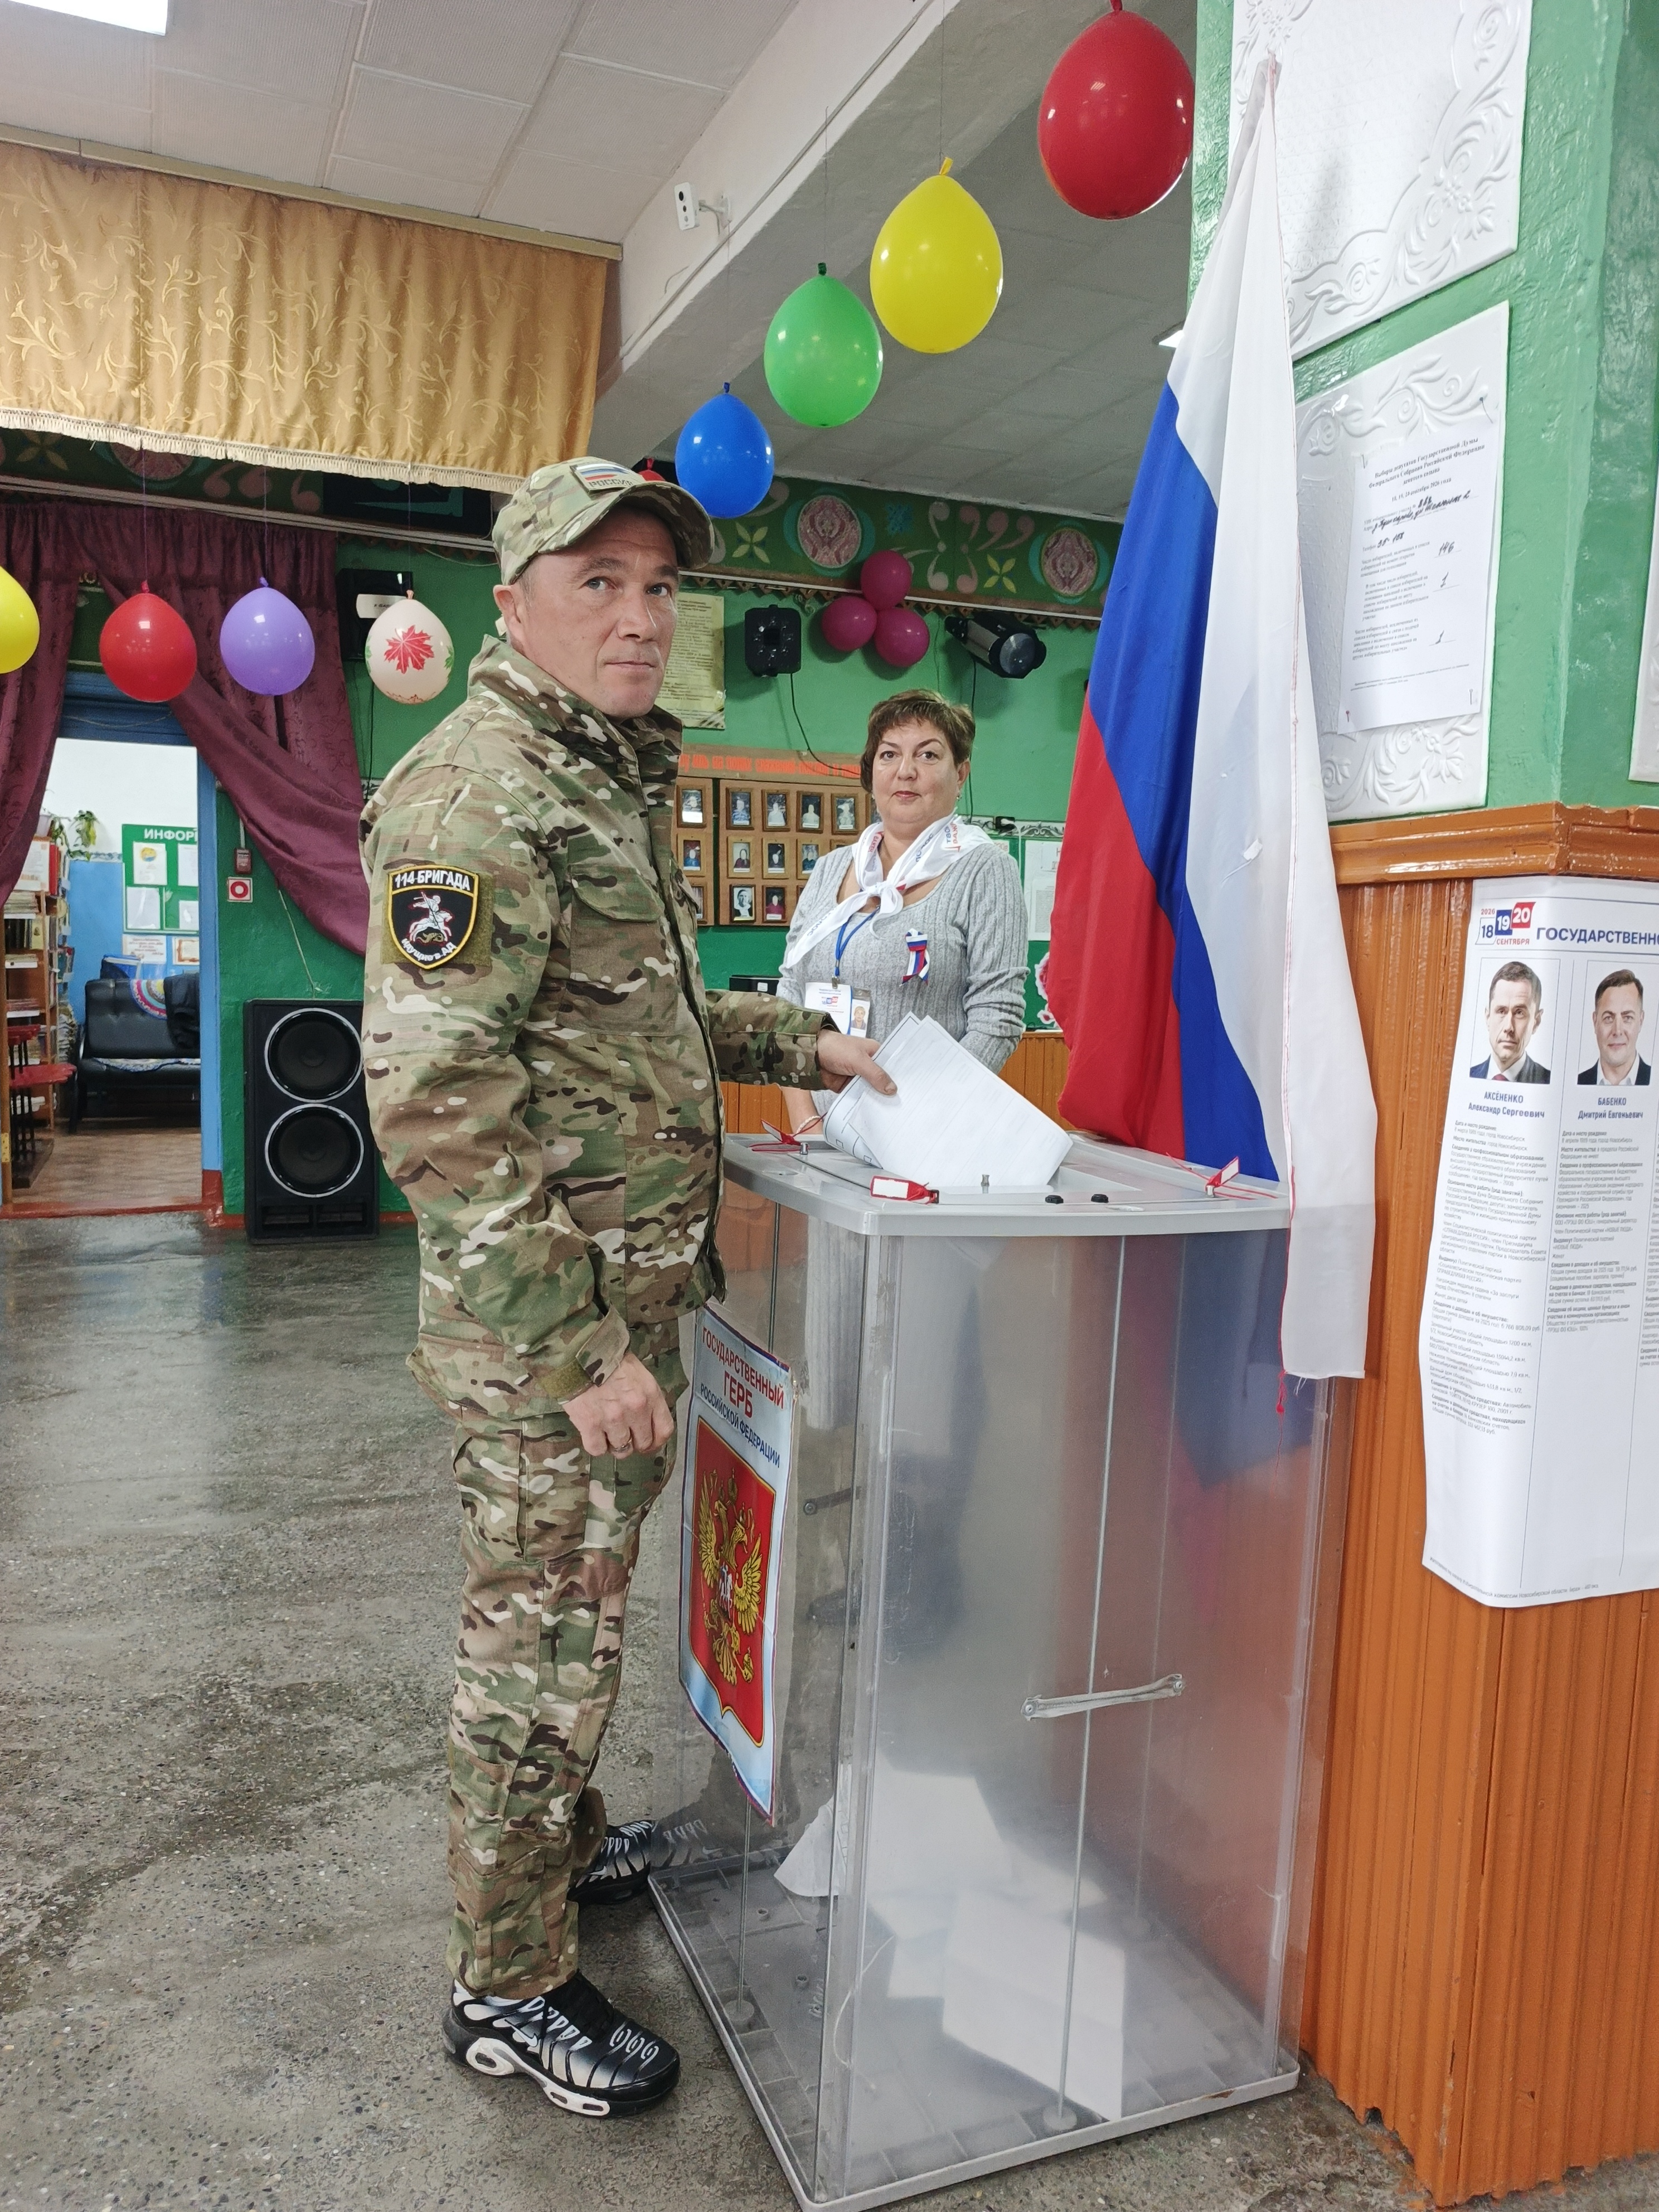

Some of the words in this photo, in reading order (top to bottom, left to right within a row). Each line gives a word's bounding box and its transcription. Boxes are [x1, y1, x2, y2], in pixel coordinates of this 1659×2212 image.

[1497, 915, 1510, 930] 19
[1512, 908, 1530, 923] 20
[1481, 925, 1493, 938] 18
[1484, 1090, 1524, 1103] АКСЁНЕНКО
[1598, 1098, 1627, 1106] БАБЕНКО
[1468, 1102, 1501, 1115] Александр
[1502, 1107, 1545, 1118] Сергеевич
[1578, 1110, 1606, 1120] Дмитрий
[1608, 1110, 1643, 1119] Евгеньевич
[703, 1327, 784, 1409] ГОСУДАРСТВЕННЫЙ
[724, 1371, 753, 1419] ГЕРБ
[701, 1383, 739, 1429] РОССИЙСКОЙ
[739, 1420, 780, 1468] ФЕДЕРАЦИИ
